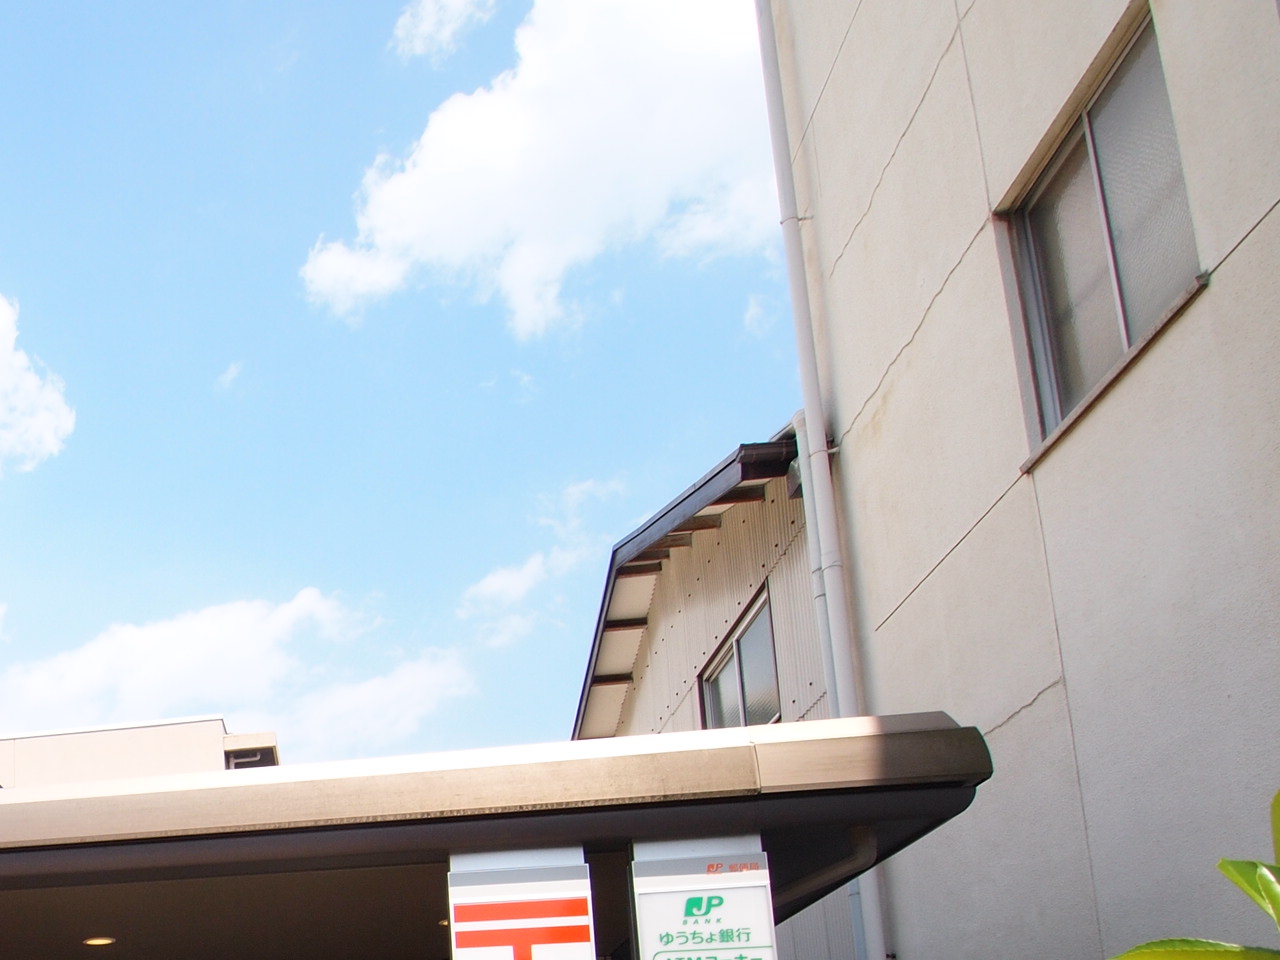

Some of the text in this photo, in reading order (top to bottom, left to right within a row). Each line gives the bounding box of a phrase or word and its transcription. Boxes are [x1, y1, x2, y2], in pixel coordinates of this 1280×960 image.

[684, 895, 725, 917] JP
[682, 918, 722, 926] BANK
[658, 927, 752, 946] ゆうちょ銀行
